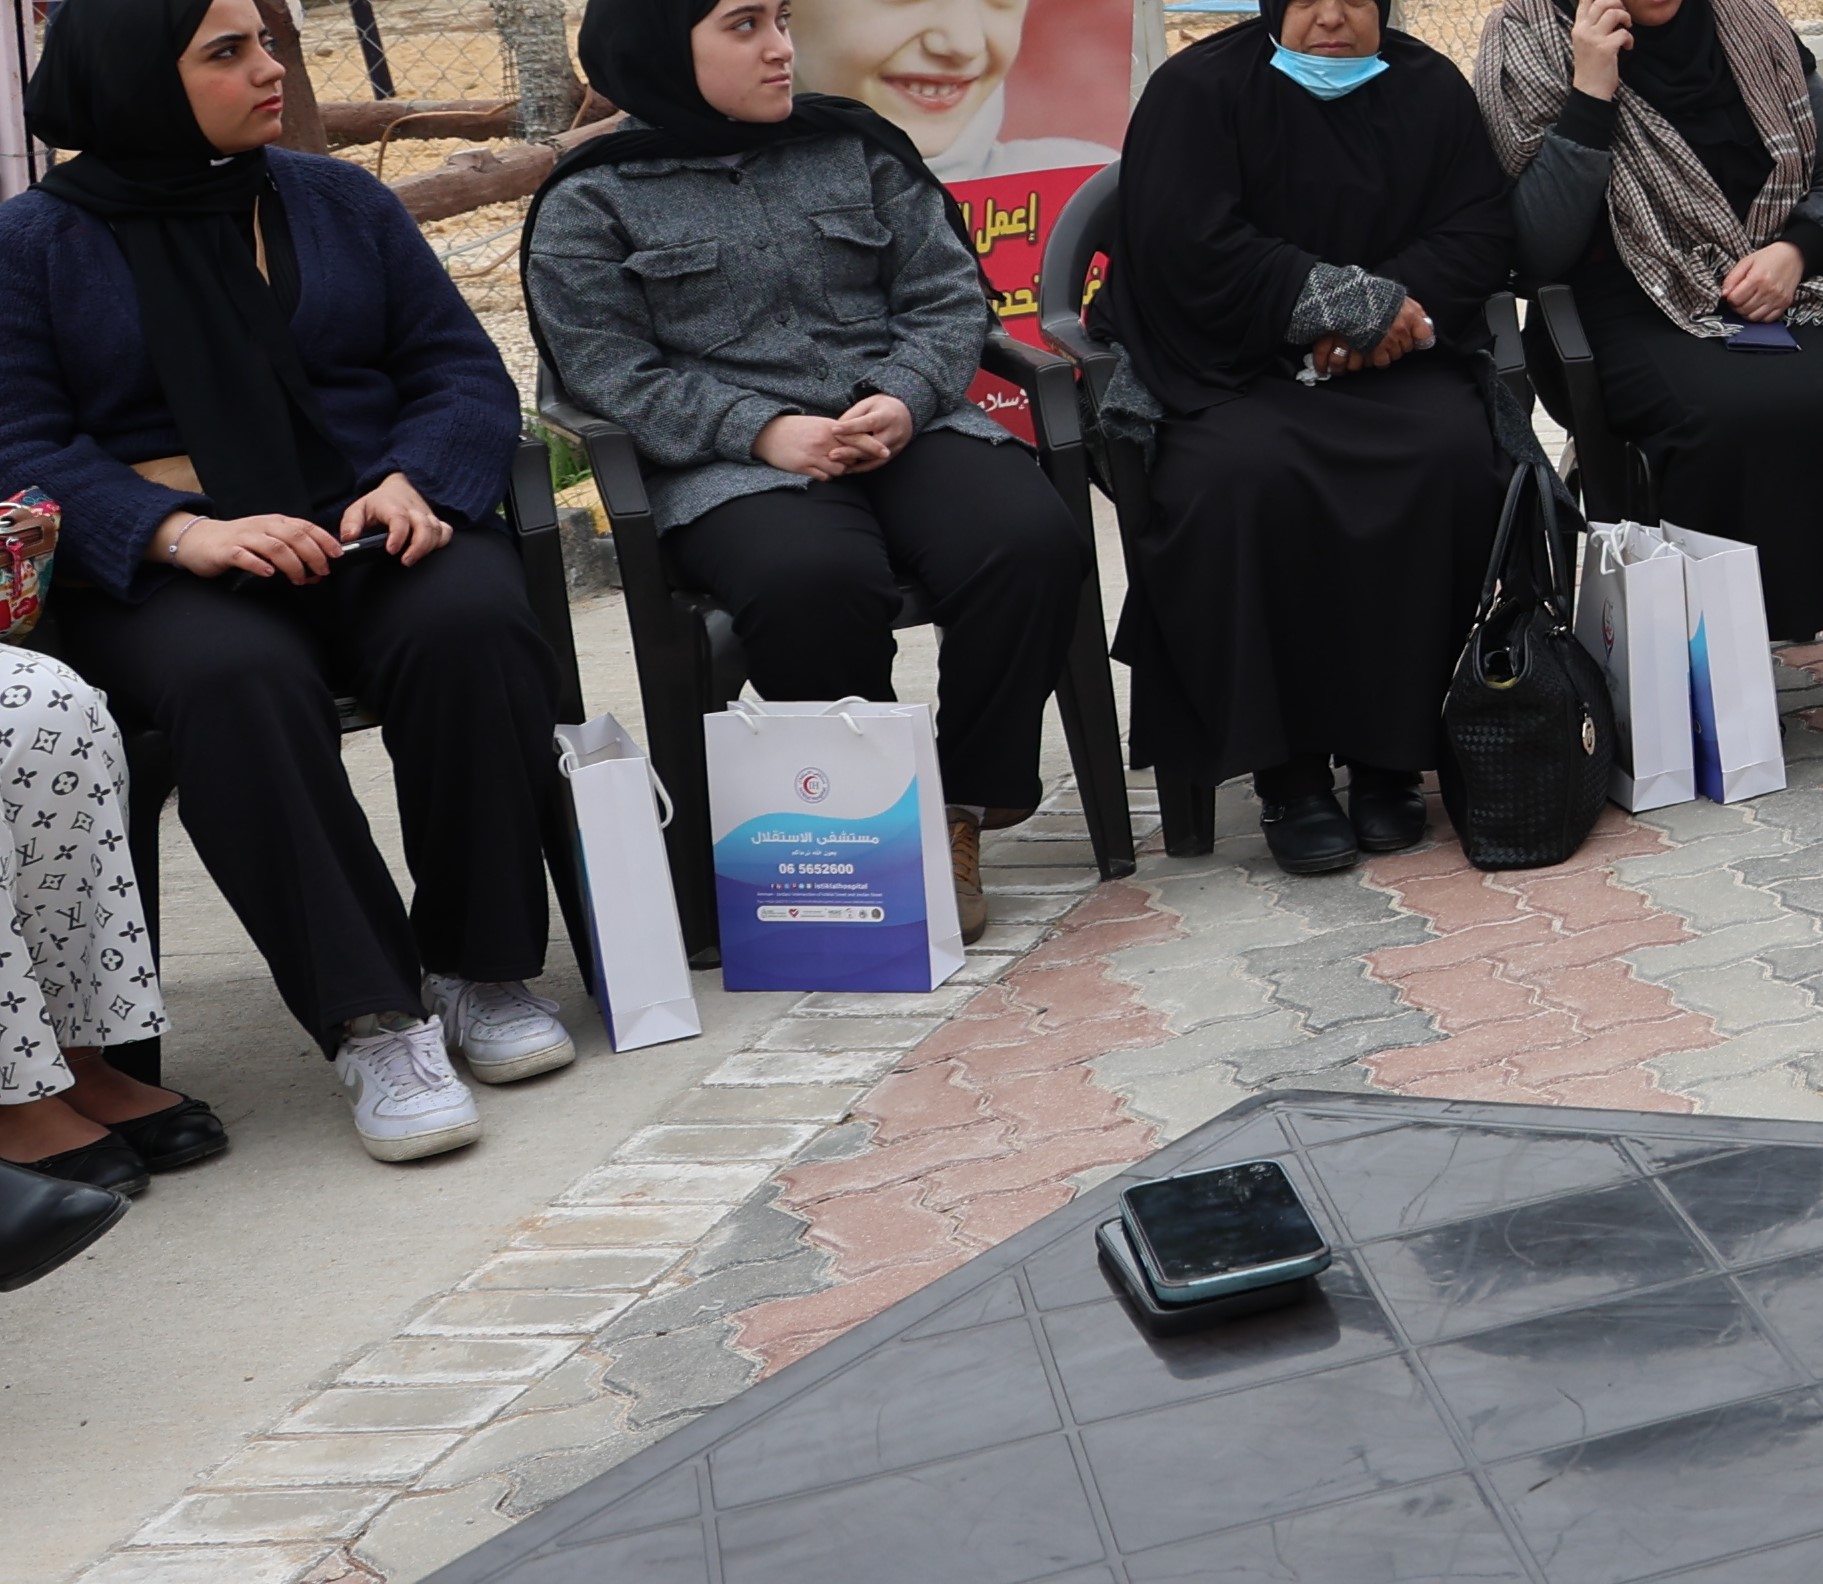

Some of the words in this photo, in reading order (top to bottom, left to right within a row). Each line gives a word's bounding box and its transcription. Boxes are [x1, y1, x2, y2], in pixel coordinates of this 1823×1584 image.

[751, 830, 813, 845] الاستقلال
[816, 831, 880, 845] مستشفى
[779, 863, 795, 874] 06
[798, 863, 854, 874] 5652600
